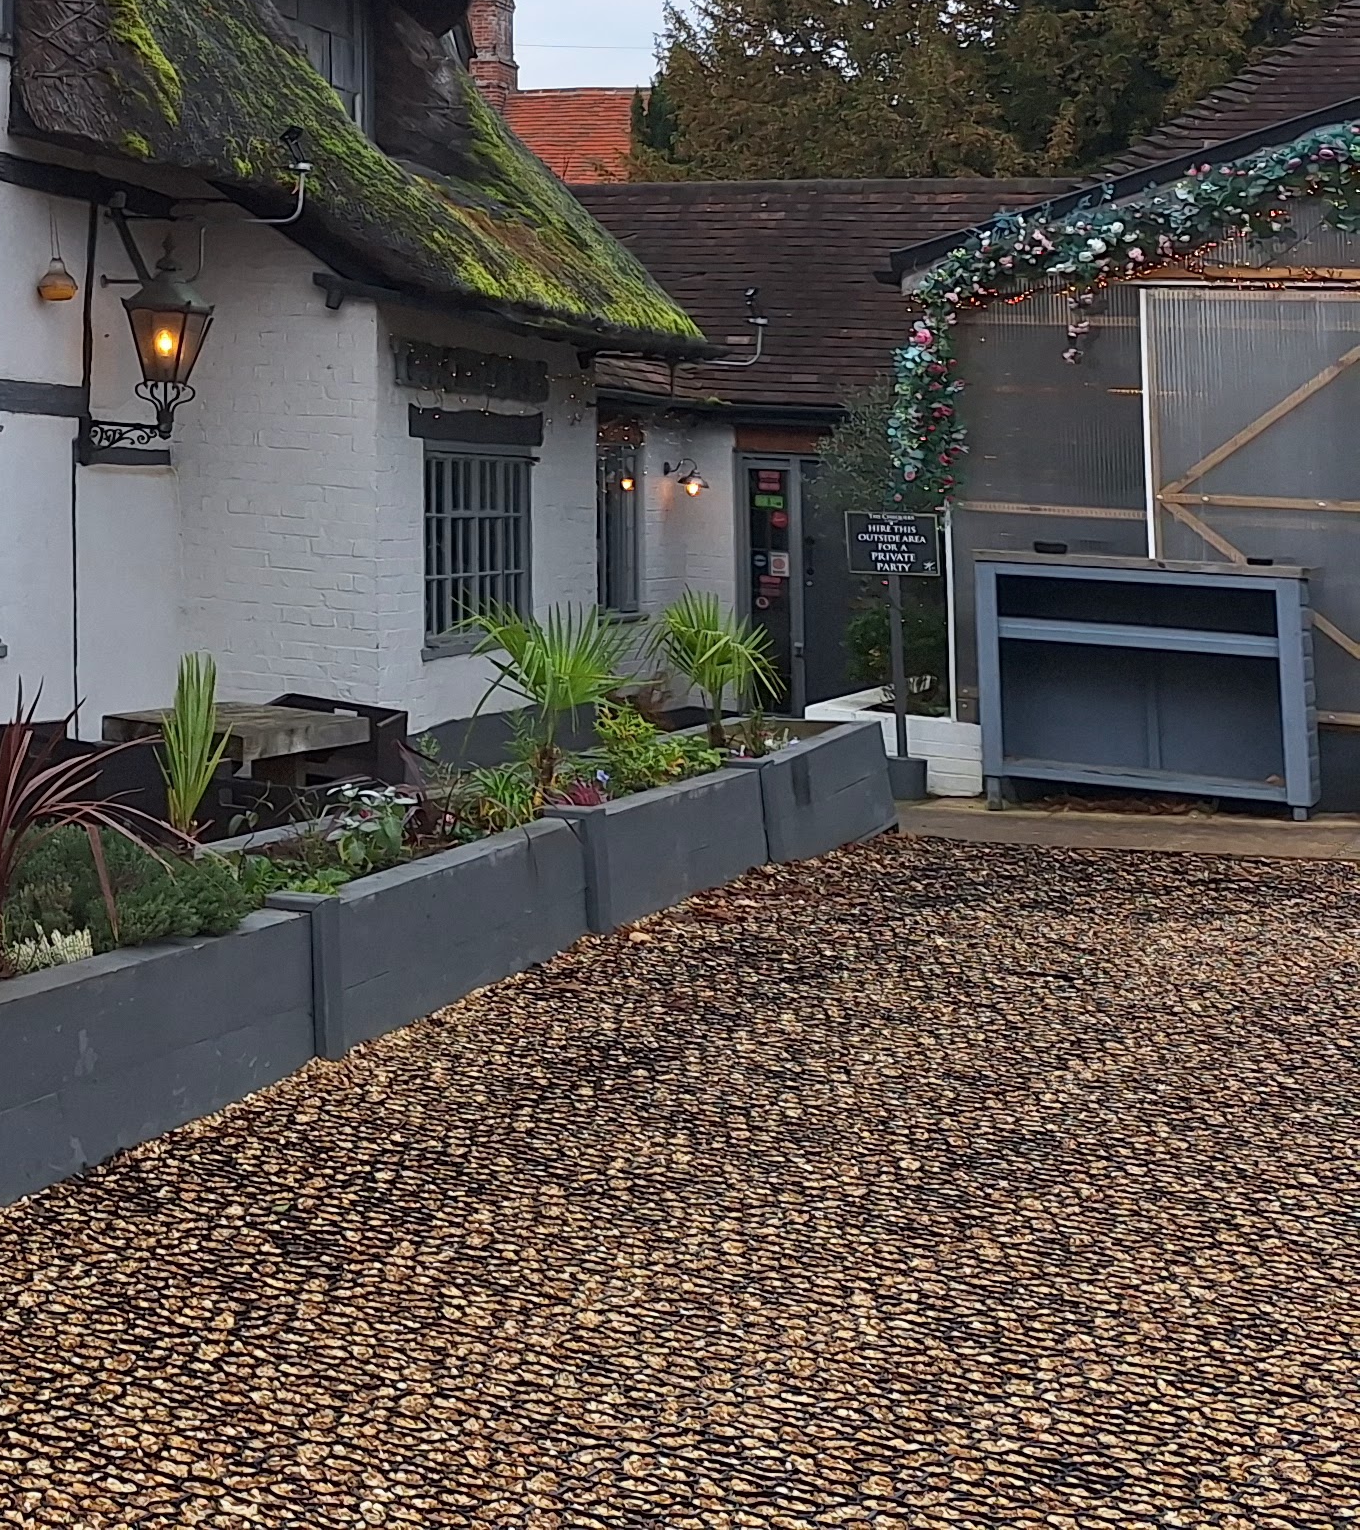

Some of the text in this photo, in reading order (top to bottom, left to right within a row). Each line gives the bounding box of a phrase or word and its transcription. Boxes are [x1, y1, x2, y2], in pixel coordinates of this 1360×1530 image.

[868, 524, 917, 534] HIRE THIS
[858, 533, 927, 544] OUTSIDE AREA
[878, 542, 908, 552] FOR A
[871, 551, 916, 562] PRIVATE
[876, 562, 911, 572] PARTY
